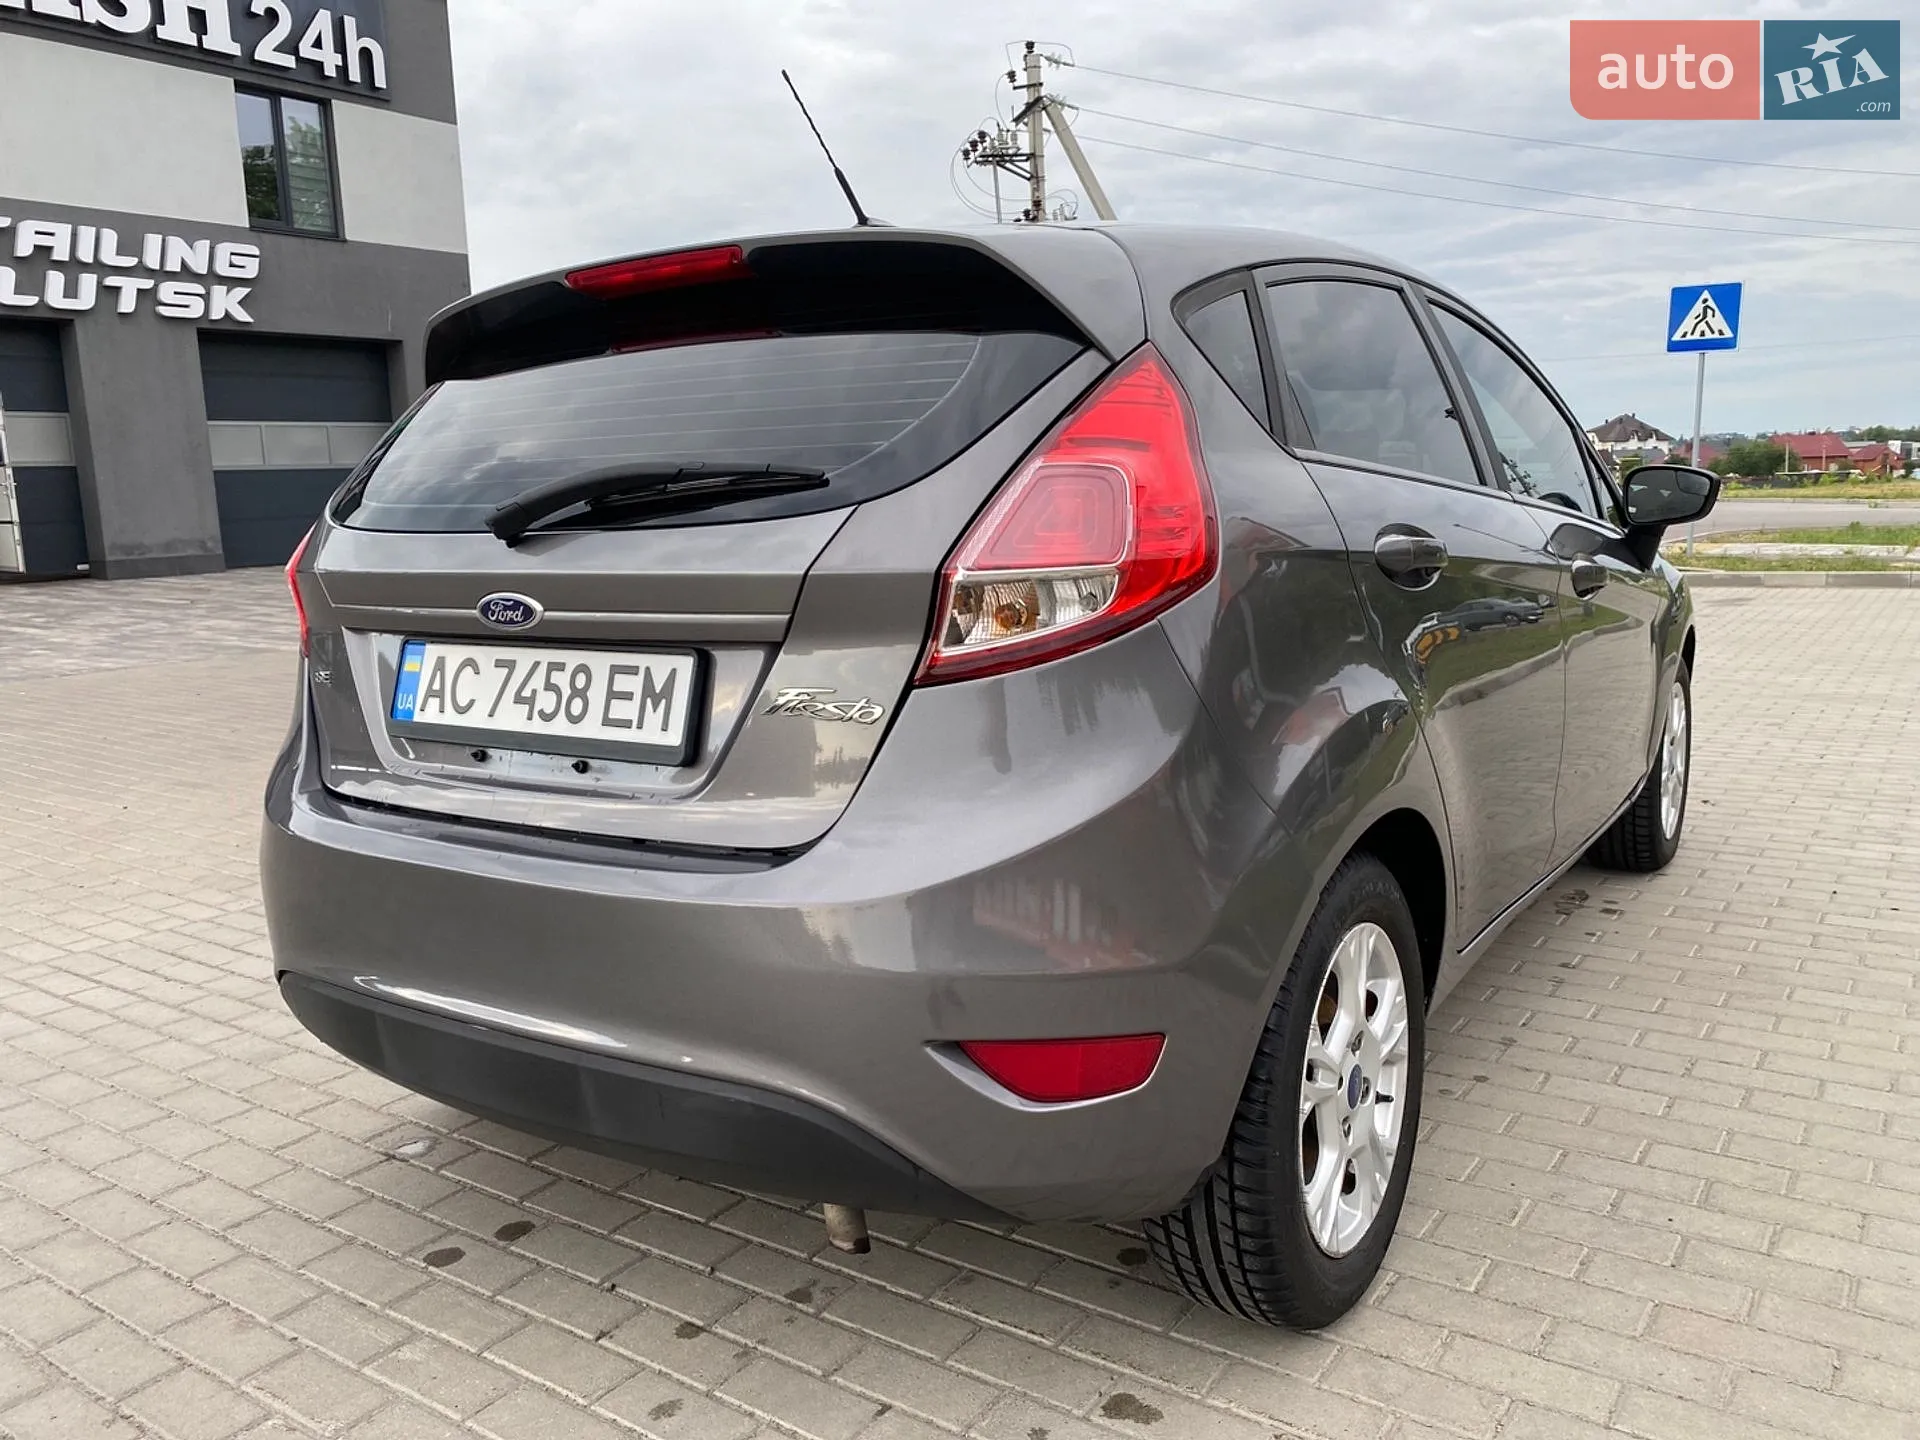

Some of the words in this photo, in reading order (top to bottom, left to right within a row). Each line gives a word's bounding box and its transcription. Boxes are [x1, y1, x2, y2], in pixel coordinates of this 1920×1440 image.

[250, 0, 387, 89] 24h
[0, 216, 260, 279] AILING
[0, 265, 254, 323] LUTSK
[488, 600, 524, 621] Ford
[397, 692, 414, 710] UA
[419, 656, 480, 715] AC
[487, 658, 592, 725] 7458
[601, 664, 677, 731] EM
[760, 687, 885, 725] Fiesta
